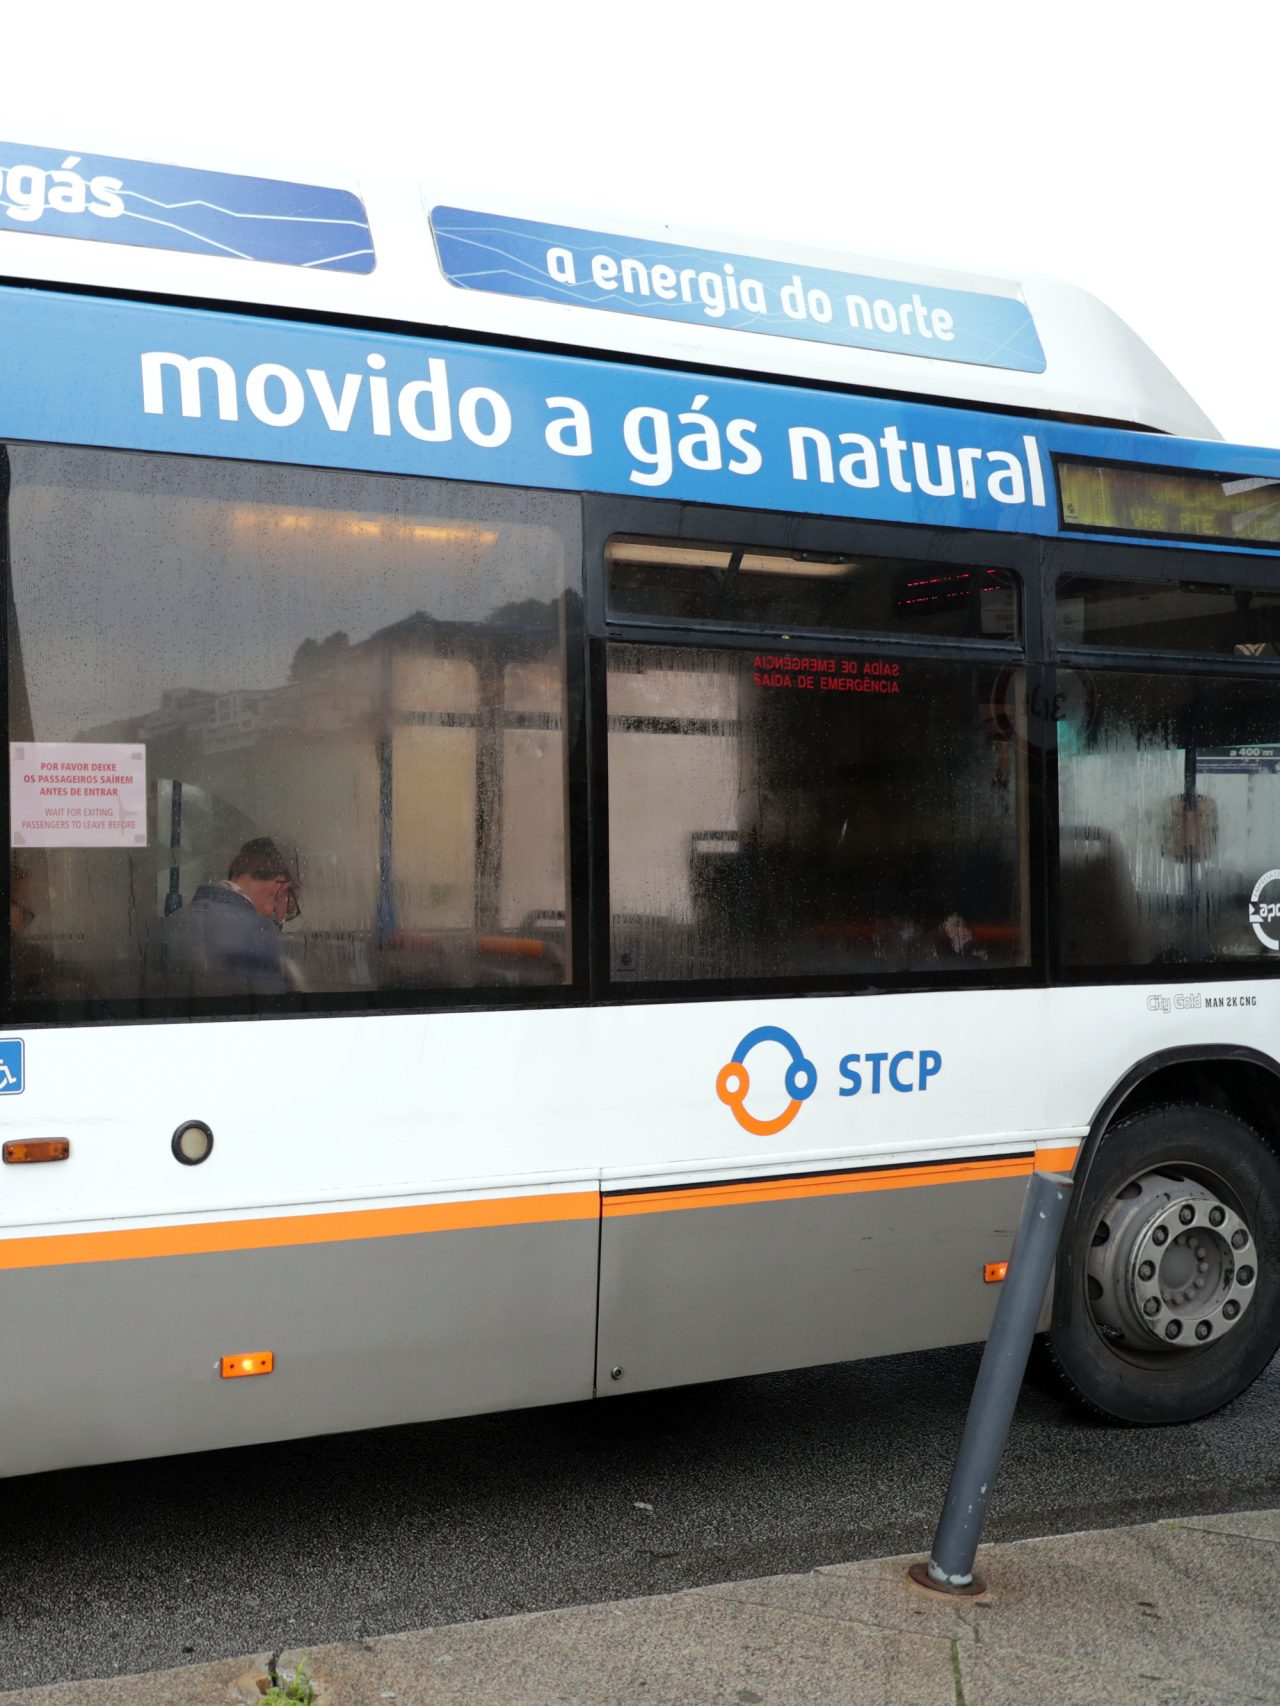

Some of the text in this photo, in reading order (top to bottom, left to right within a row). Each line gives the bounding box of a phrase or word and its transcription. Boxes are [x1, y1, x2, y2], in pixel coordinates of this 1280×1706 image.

[546, 247, 955, 341] a energia do norte
[141, 351, 512, 448] movido
[546, 396, 592, 456] a
[624, 394, 763, 489] gás
[789, 427, 1047, 507] natural
[752, 672, 900, 694] SAÍDA DE EMERGÊNCIA
[1239, 748, 1260, 756] 400
[1262, 749, 1274, 757] m
[40, 762, 117, 772] POR FAVOR DEIXE
[23, 774, 134, 784] OS PASSAGEIROS SAÍREM
[40, 788, 118, 796] ANTES DE ENTRAR
[45, 808, 113, 817] WAIT FOR EXITING
[22, 820, 136, 829] PASSENGERS TO LEAVE BEFORE
[1146, 993, 1257, 1014] City Gold MAN 2K CNG
[839, 1050, 942, 1097] STCP
